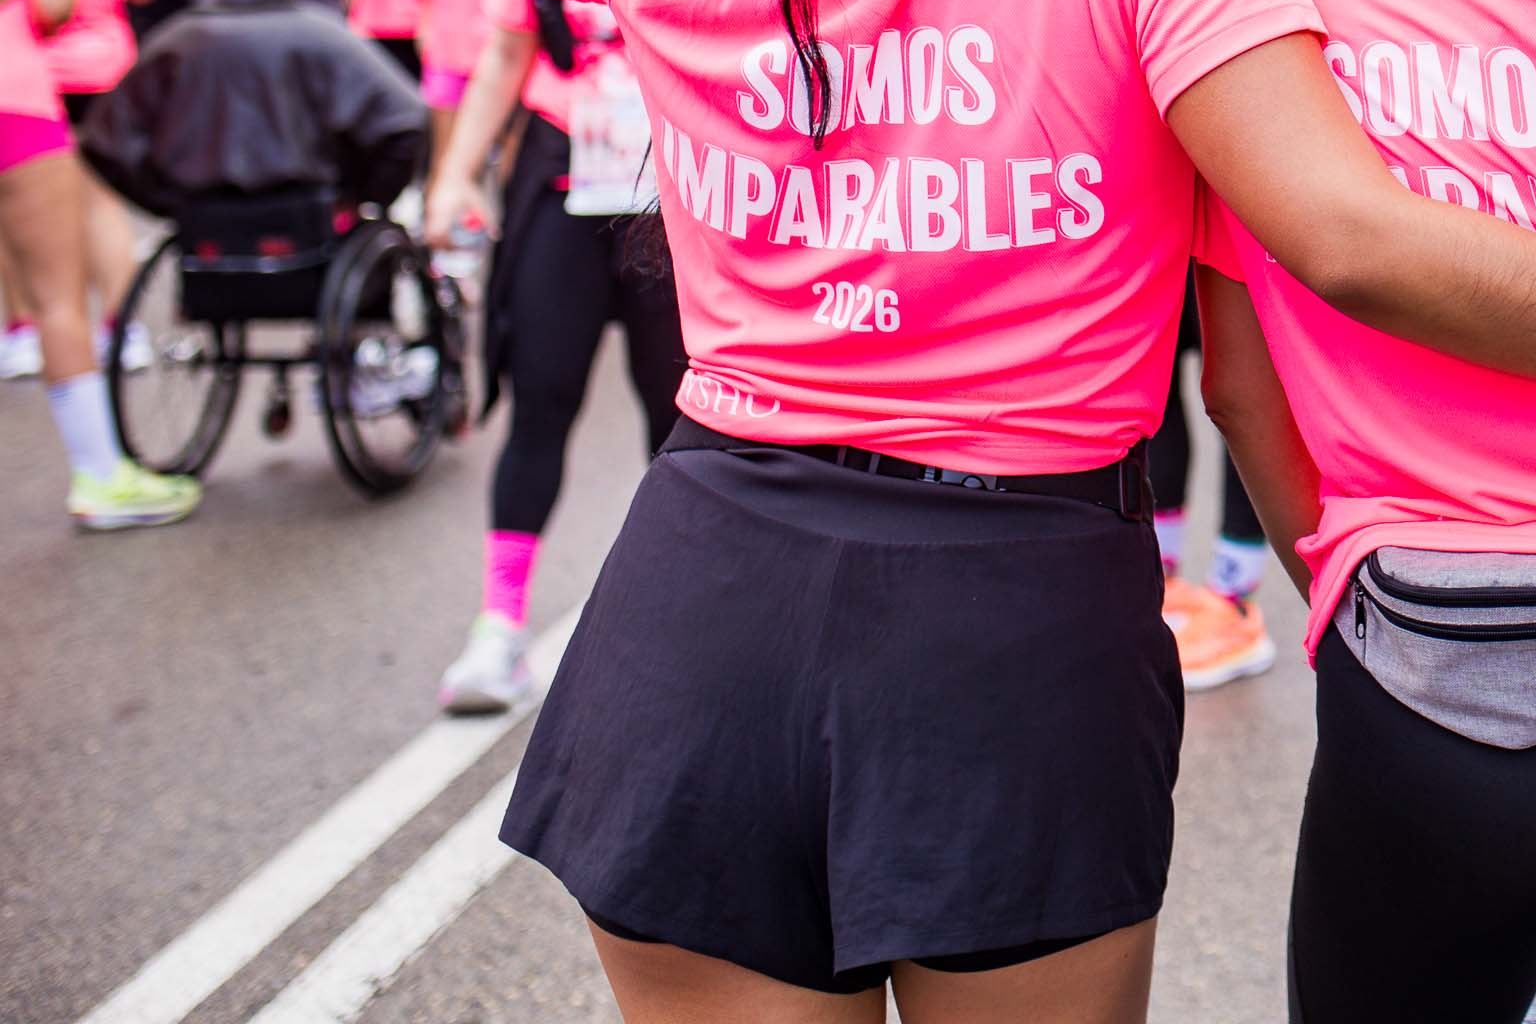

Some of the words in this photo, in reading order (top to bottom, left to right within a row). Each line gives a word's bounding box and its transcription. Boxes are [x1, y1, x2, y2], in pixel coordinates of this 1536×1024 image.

[736, 24, 997, 137] SOMOS
[662, 116, 1105, 254] IMPARABLES
[811, 280, 900, 334] 2026
